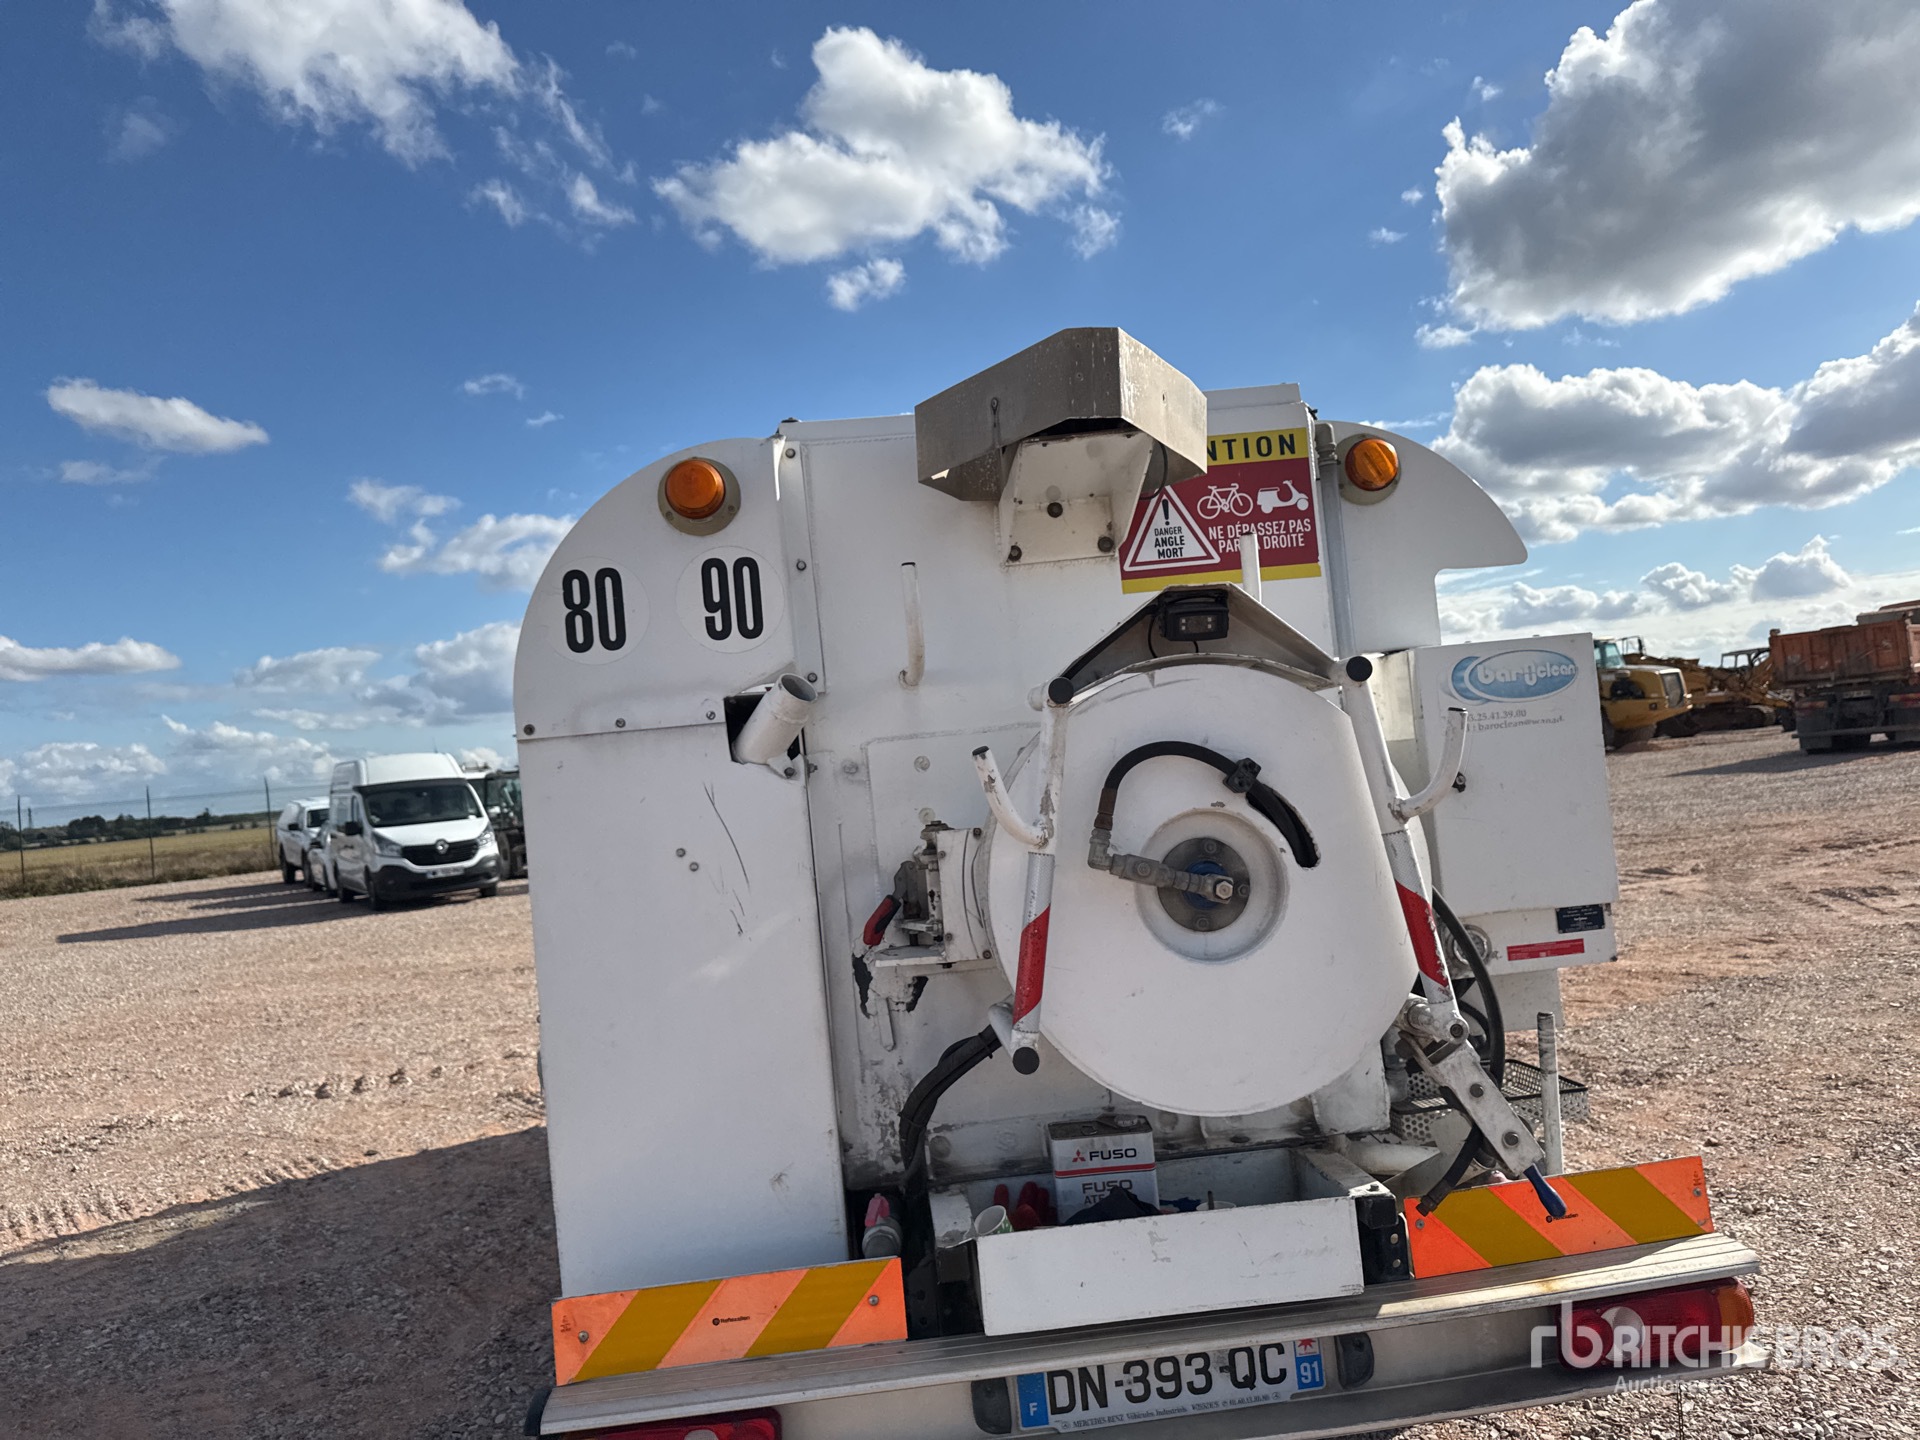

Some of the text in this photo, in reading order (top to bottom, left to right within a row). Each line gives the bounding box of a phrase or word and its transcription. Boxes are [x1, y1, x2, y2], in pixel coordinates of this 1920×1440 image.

[1207, 433, 1296, 461] NTION
[1154, 526, 1182, 537] DANGER
[1208, 518, 1311, 540] NE DÉPASSEZ PAS
[1154, 536, 1185, 548] ANGLE
[1218, 538, 1241, 553] PAR
[1263, 533, 1305, 550] DROITE
[1157, 547, 1183, 559] MORT
[701, 556, 764, 641] 90
[562, 567, 626, 653] 80
[1467, 709, 1527, 721] 3.25.41.39.00
[1089, 1148, 1137, 1161] FUSO
[1082, 1180, 1133, 1194] FUSO
[1029, 1402, 1038, 1417] F
[1047, 1343, 1287, 1415] DN-393-QC
[1300, 1360, 1320, 1384] 91
